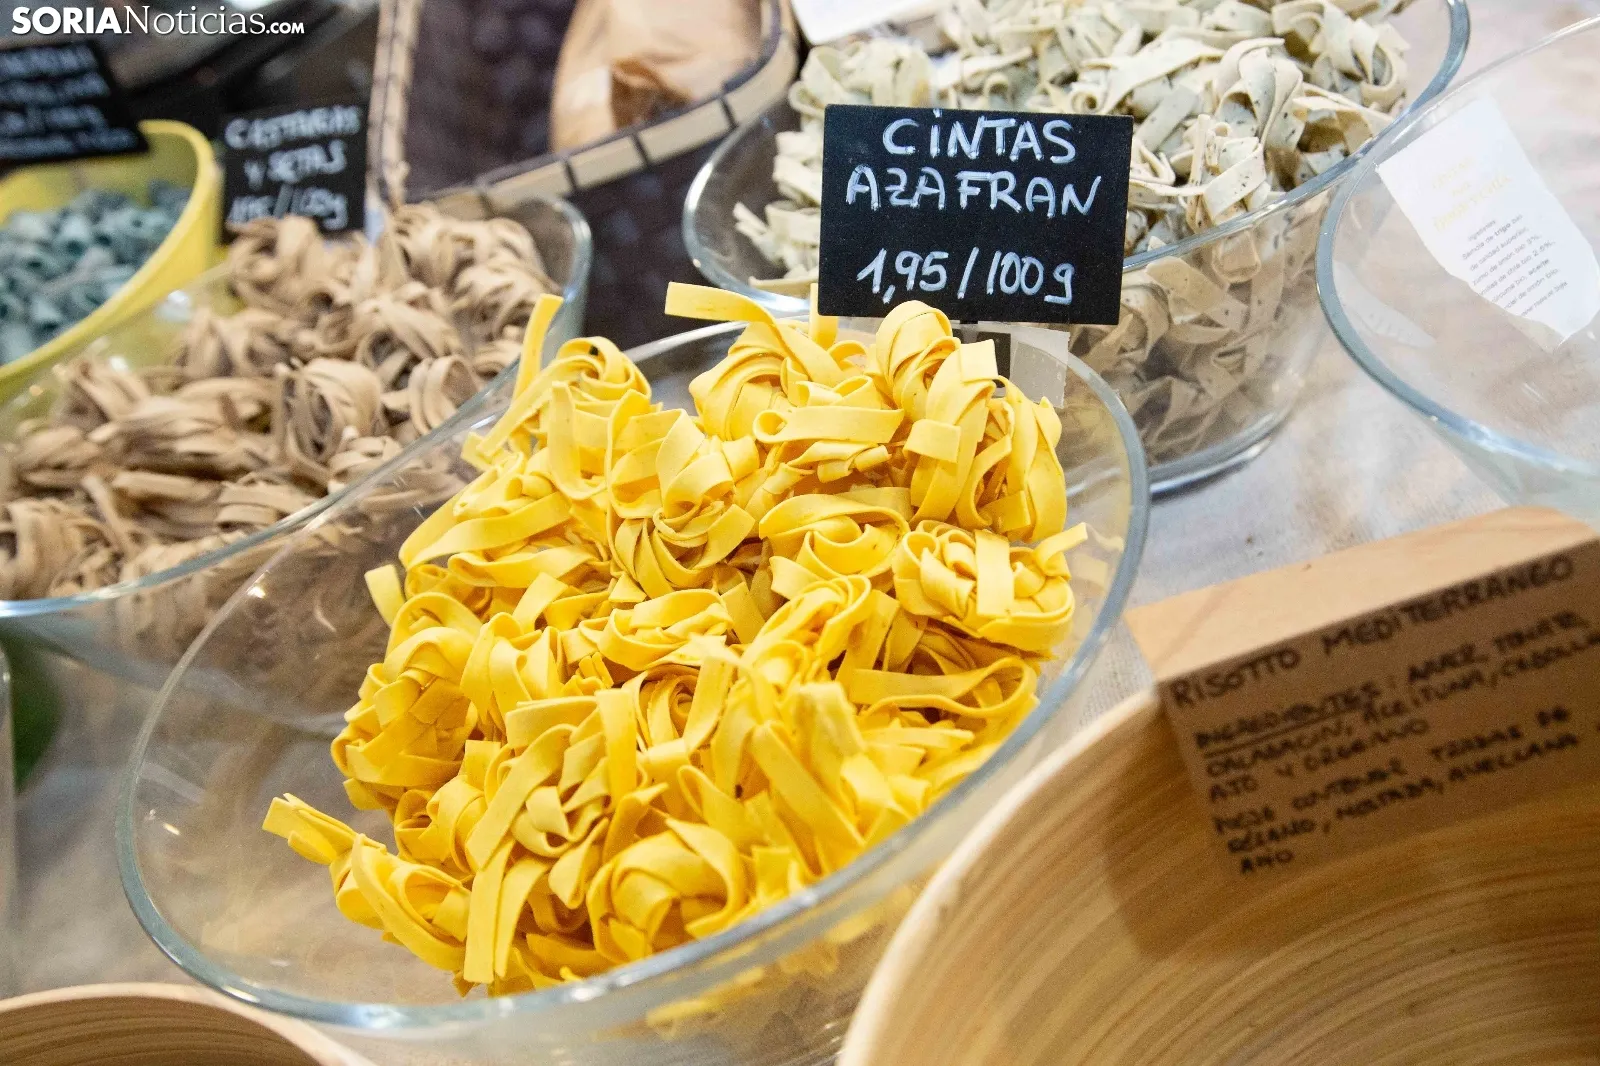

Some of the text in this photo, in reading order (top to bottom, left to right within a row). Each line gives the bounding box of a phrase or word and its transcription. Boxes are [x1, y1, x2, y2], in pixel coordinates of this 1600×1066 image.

[845, 164, 1101, 218] AZAFRAN
[1494, 222, 1511, 237] trigo
[1169, 647, 1300, 708] RISOTTO
